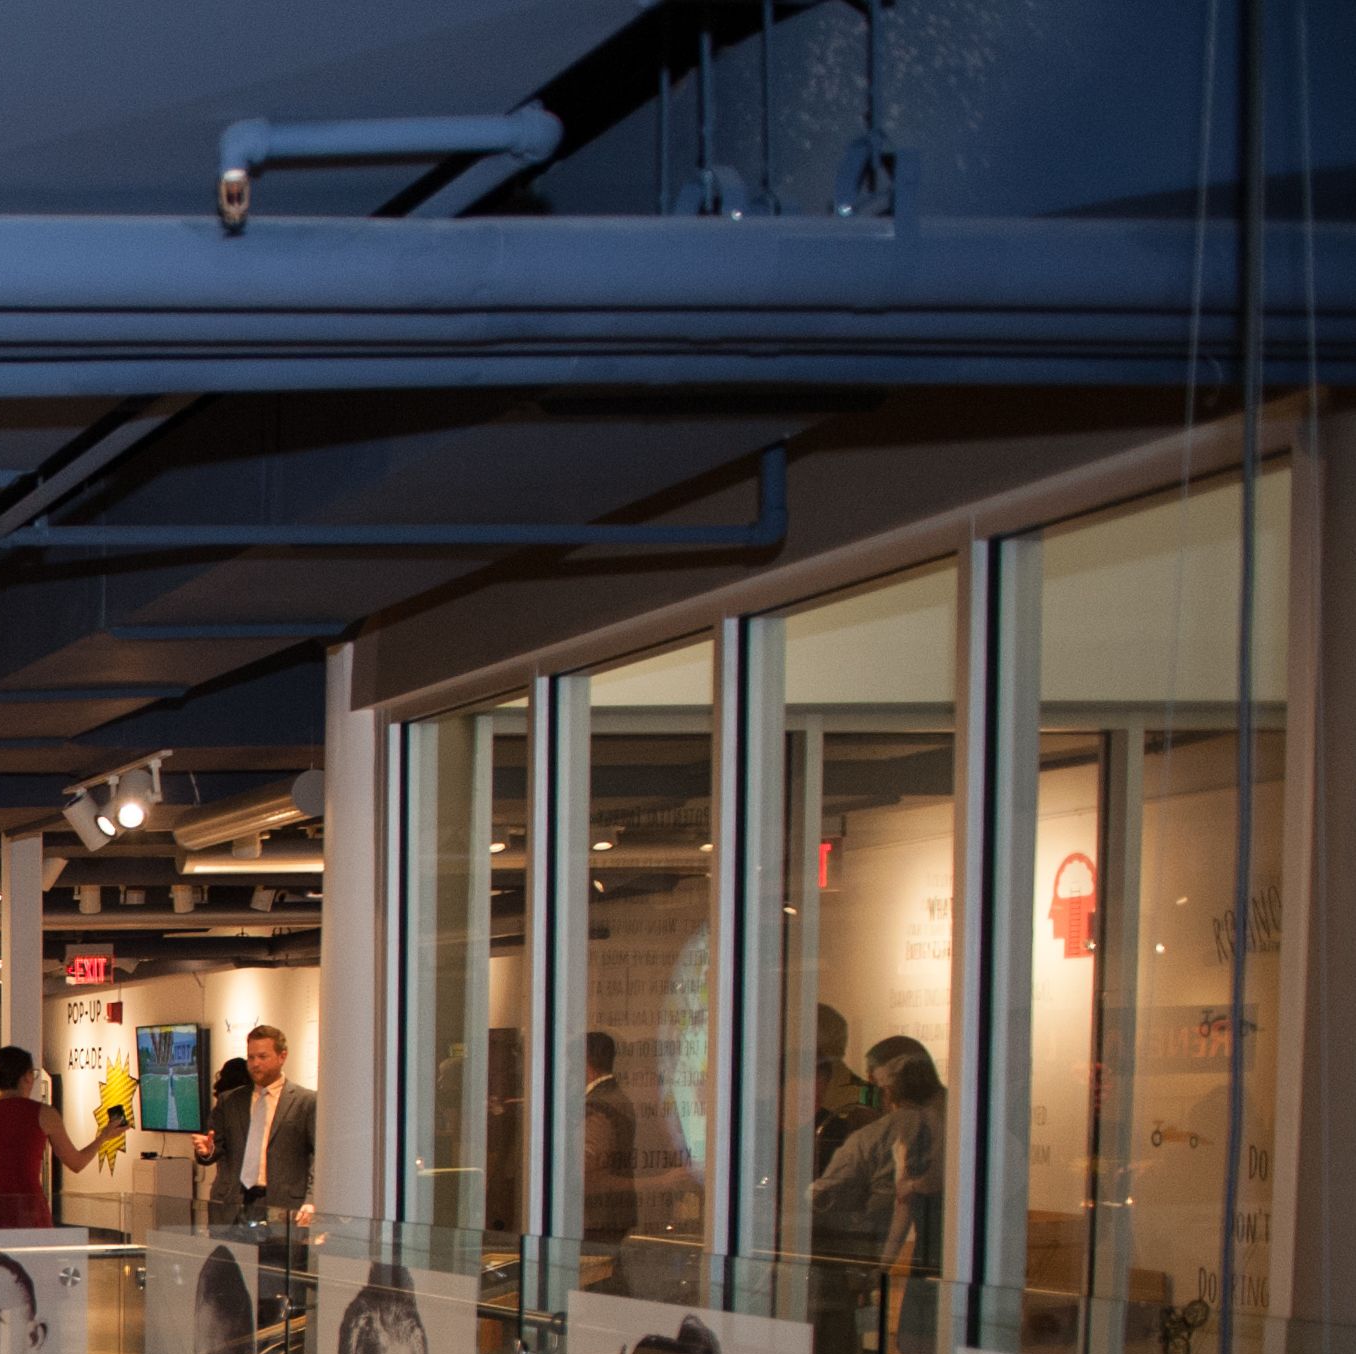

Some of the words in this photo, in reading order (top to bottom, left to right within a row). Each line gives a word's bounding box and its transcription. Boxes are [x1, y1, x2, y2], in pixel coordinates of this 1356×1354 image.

[74, 957, 107, 984] EXIT
[67, 1000, 102, 1025] POP-UP
[68, 1047, 103, 1070] ARCADE
[1233, 1208, 1271, 1244] ON'T
